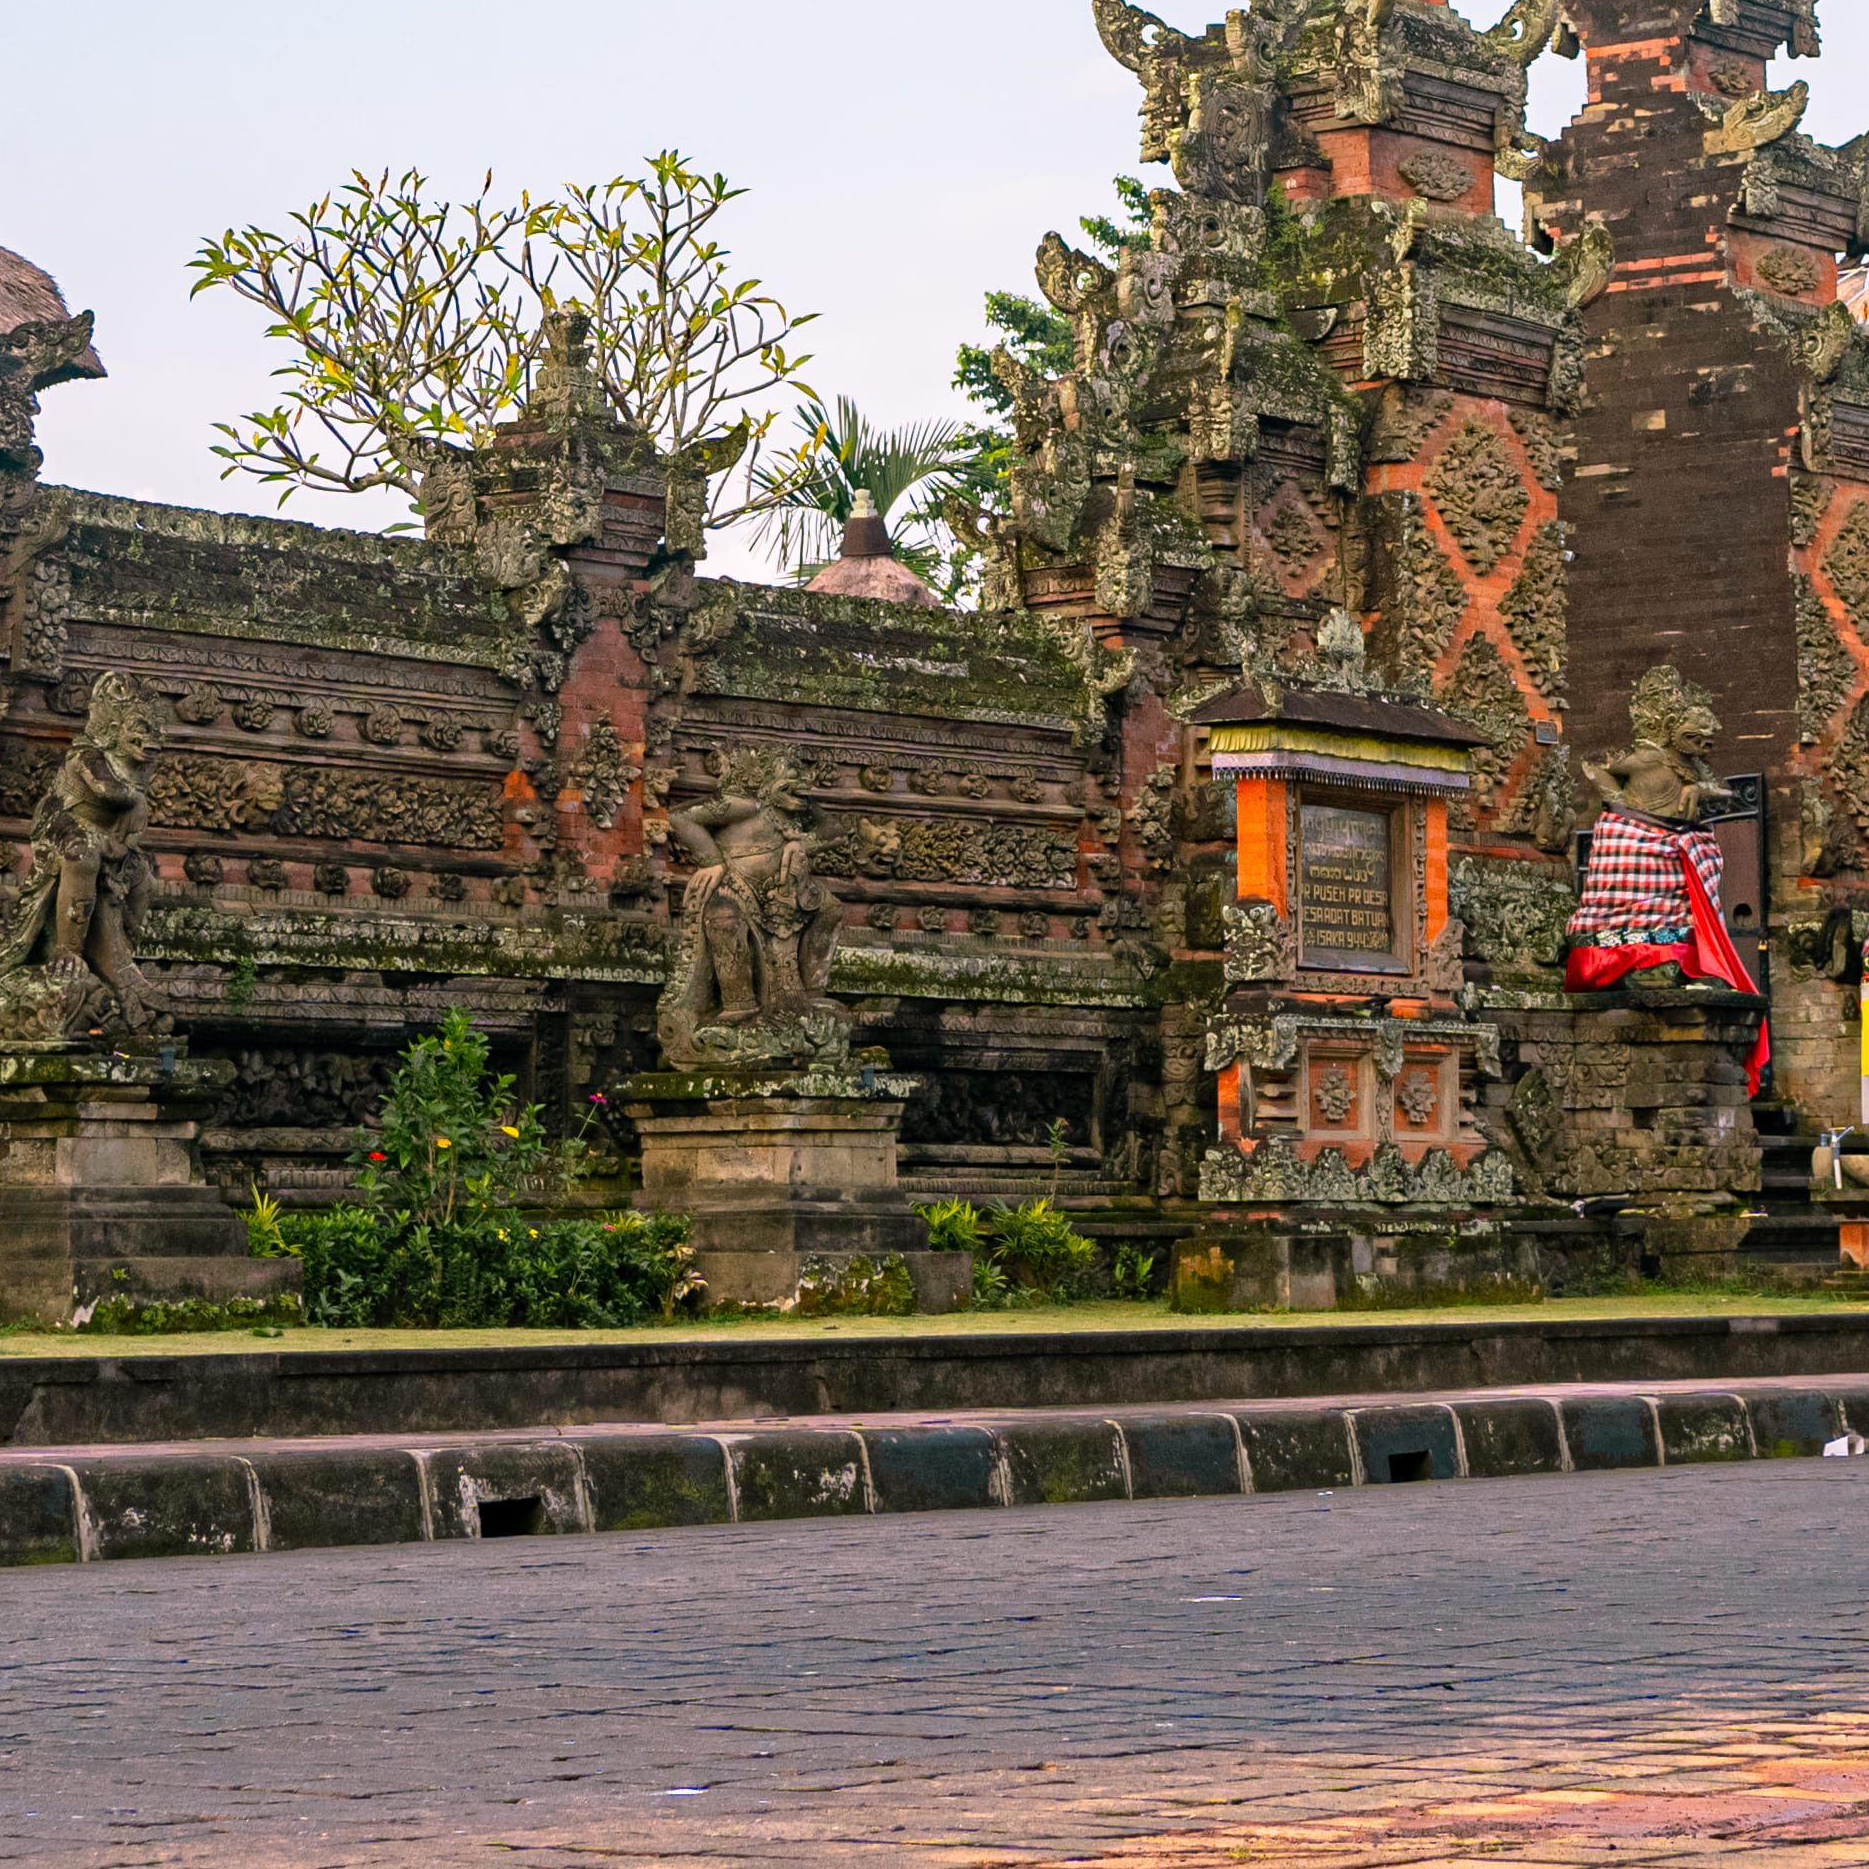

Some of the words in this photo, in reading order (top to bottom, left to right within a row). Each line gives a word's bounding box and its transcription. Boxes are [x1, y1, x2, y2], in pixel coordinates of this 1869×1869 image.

[1301, 884, 1310, 900] R
[1313, 885, 1345, 902] PUSEH
[1348, 888, 1361, 904] PR
[1363, 890, 1388, 906] DESA
[1304, 906, 1323, 923] ESA
[1324, 907, 1350, 924] ADAT
[1317, 930, 1345, 947] ISAKA
